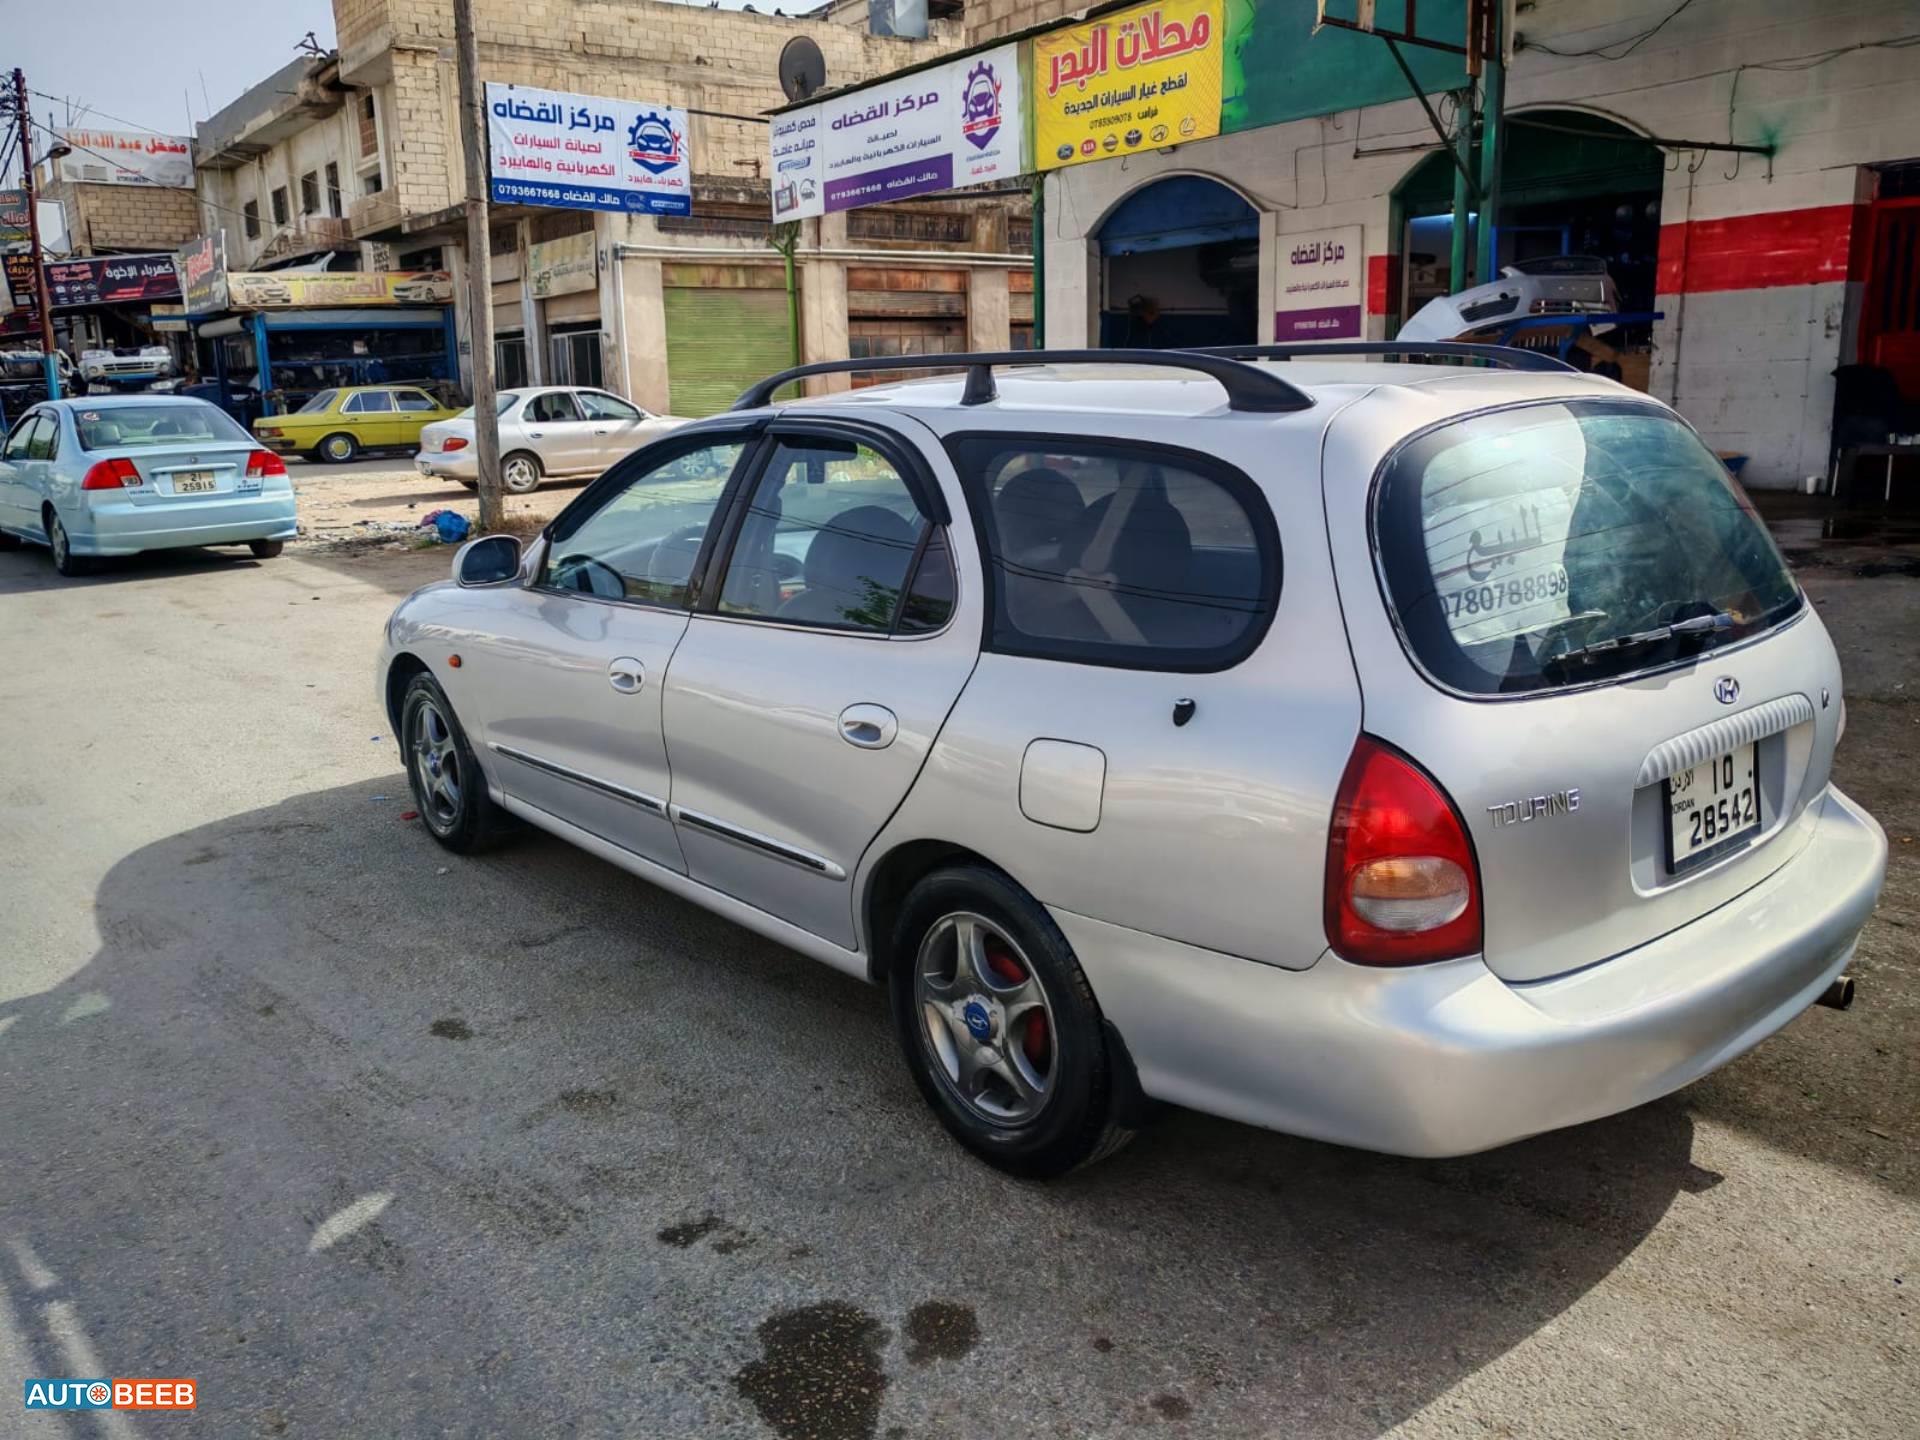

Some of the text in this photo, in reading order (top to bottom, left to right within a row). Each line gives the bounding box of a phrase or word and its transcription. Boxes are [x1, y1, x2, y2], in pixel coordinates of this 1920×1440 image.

[1048, 11, 1211, 96] محلات البدر
[1064, 72, 1188, 116] لقطع غيار السيارات الجديدة
[493, 98, 615, 132] مركز القضاه
[831, 91, 939, 131] مركز القضاه
[514, 132, 560, 149] السيارات
[906, 135, 941, 150] السيارات
[556, 159, 615, 176] الكهربائية
[916, 172, 938, 183] مالك
[886, 175, 915, 189] القضاه
[563, 189, 596, 205] القضاه
[597, 193, 620, 205] مالك
[1291, 241, 1345, 266] مركز القضاه
[141, 262, 173, 277] كهرباء
[1713, 754, 1733, 794] 10
[1486, 788, 1580, 829] TOURING
[1690, 787, 1753, 847] 28542
